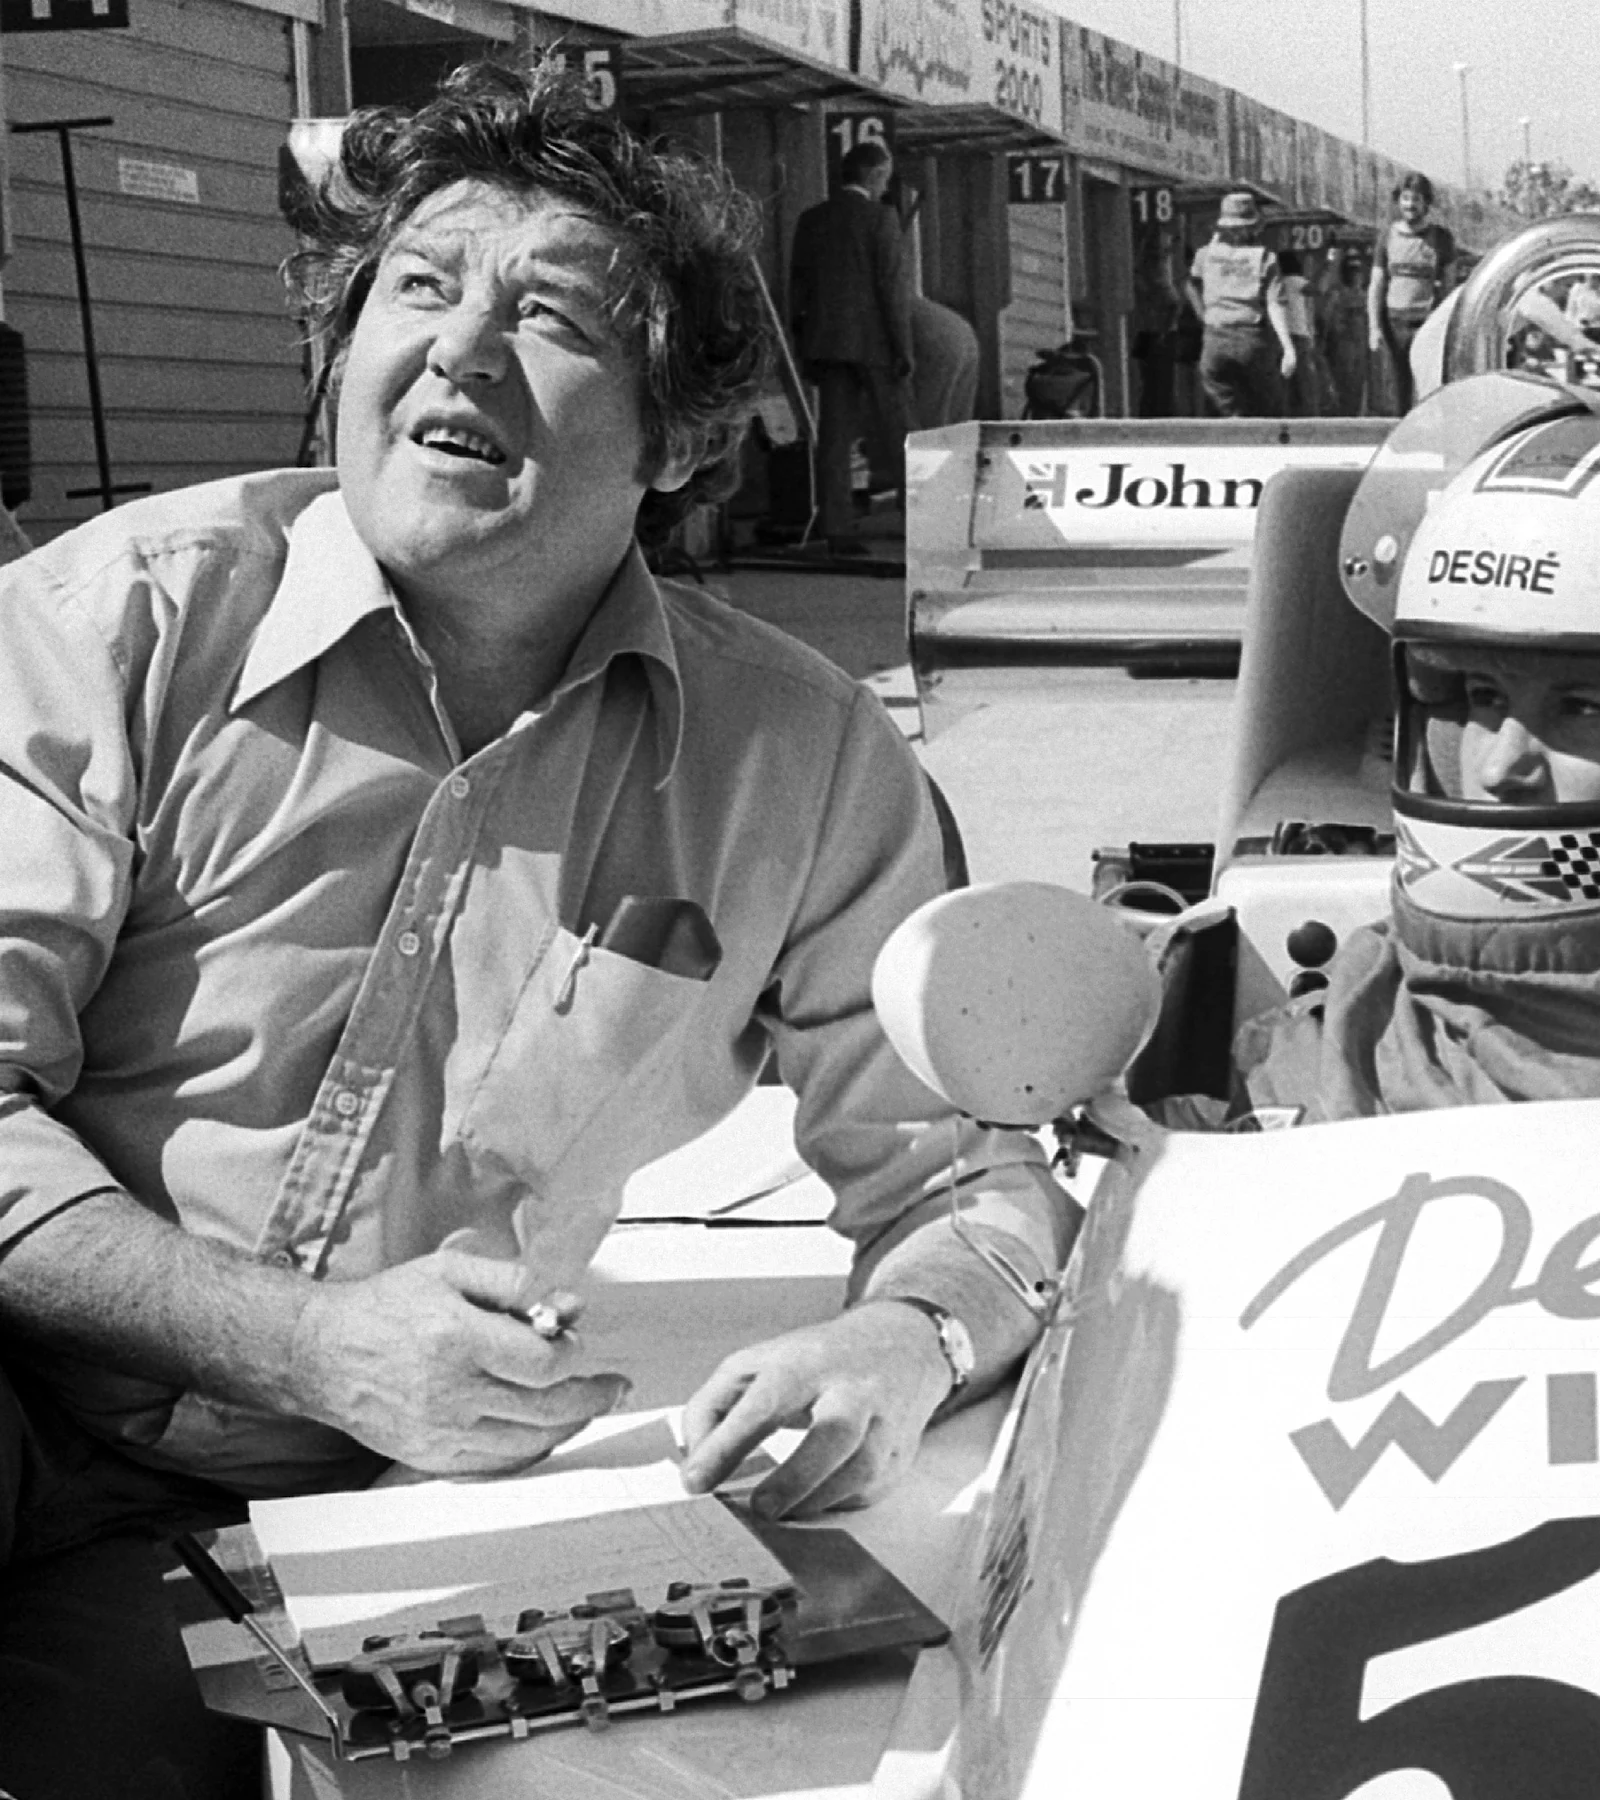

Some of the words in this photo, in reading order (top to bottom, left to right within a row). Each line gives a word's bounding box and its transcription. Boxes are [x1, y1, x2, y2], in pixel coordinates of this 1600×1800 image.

[981, 0, 1049, 67] SPORTS
[995, 59, 1042, 121] 2000
[1015, 160, 1060, 198] 17
[1135, 189, 1172, 222] 18
[1293, 224, 1323, 249] 20
[1075, 463, 1264, 509] John
[1427, 549, 1560, 595] DESIRÉ
